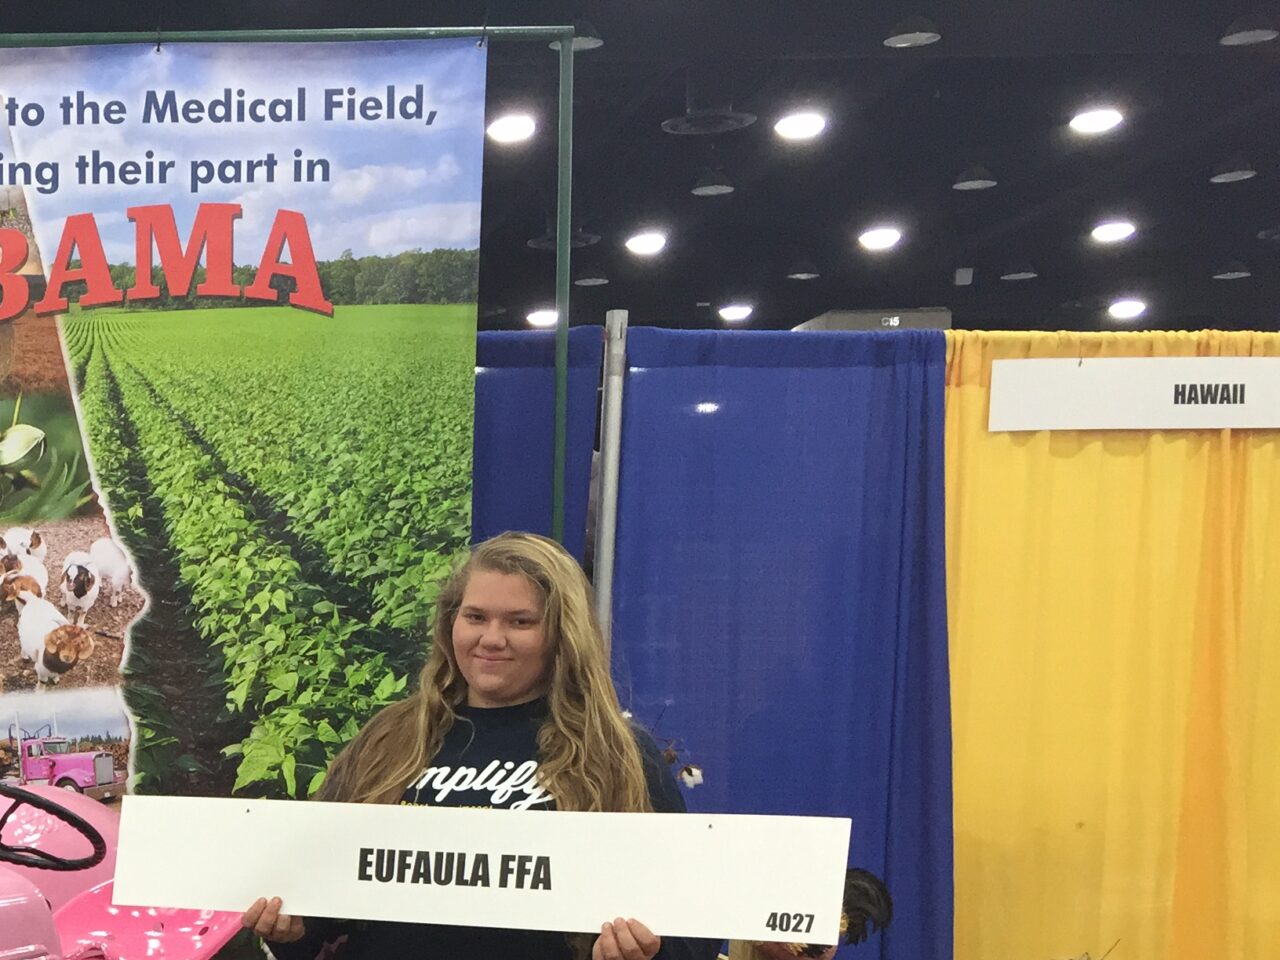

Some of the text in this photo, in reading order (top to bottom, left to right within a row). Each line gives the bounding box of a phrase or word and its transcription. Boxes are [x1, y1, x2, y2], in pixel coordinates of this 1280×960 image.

[5, 97, 45, 126] to
[60, 91, 127, 126] the
[141, 88, 307, 124] Medical
[323, 84, 438, 126] Field,
[75, 150, 175, 185] their
[190, 153, 278, 193] part
[293, 149, 331, 183] in
[881, 316, 900, 327] C15
[1173, 384, 1245, 404] HAWAII
[358, 848, 553, 891] EUFAULA FFA
[765, 911, 816, 935] 4027
